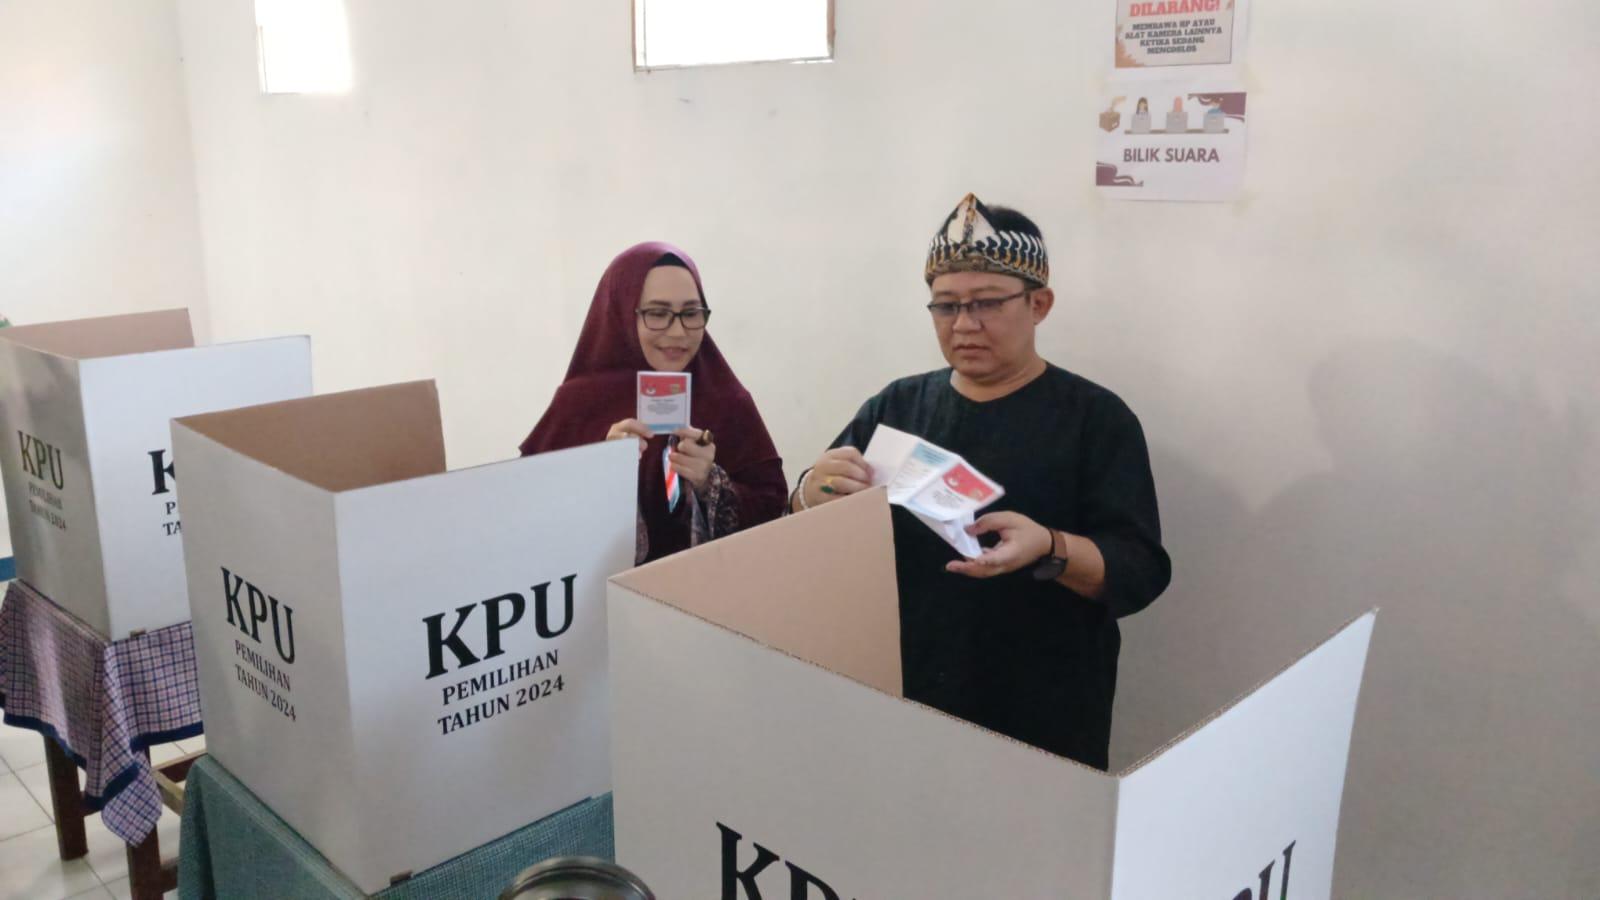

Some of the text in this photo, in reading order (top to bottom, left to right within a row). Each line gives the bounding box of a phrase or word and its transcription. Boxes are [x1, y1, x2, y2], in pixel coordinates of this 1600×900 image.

[1125, 27, 1222, 39] ALAT KAMERA LAINNYA
[1130, 0, 1220, 16] DILARANG!
[1132, 20, 1177, 30] MEMBAWA
[1140, 36, 1205, 46] KETIKA SEDANG
[1123, 147, 1220, 162] BILIK SUARA
[17, 430, 64, 490] KPU
[220, 565, 295, 665] KPU
[422, 573, 577, 680] KPU
[235, 639, 291, 692] PEMILIHAN
[235, 664, 296, 722] TAHUN 2024
[442, 649, 559, 706] PEMILIHAN
[437, 674, 565, 735] TAHUN 2024
